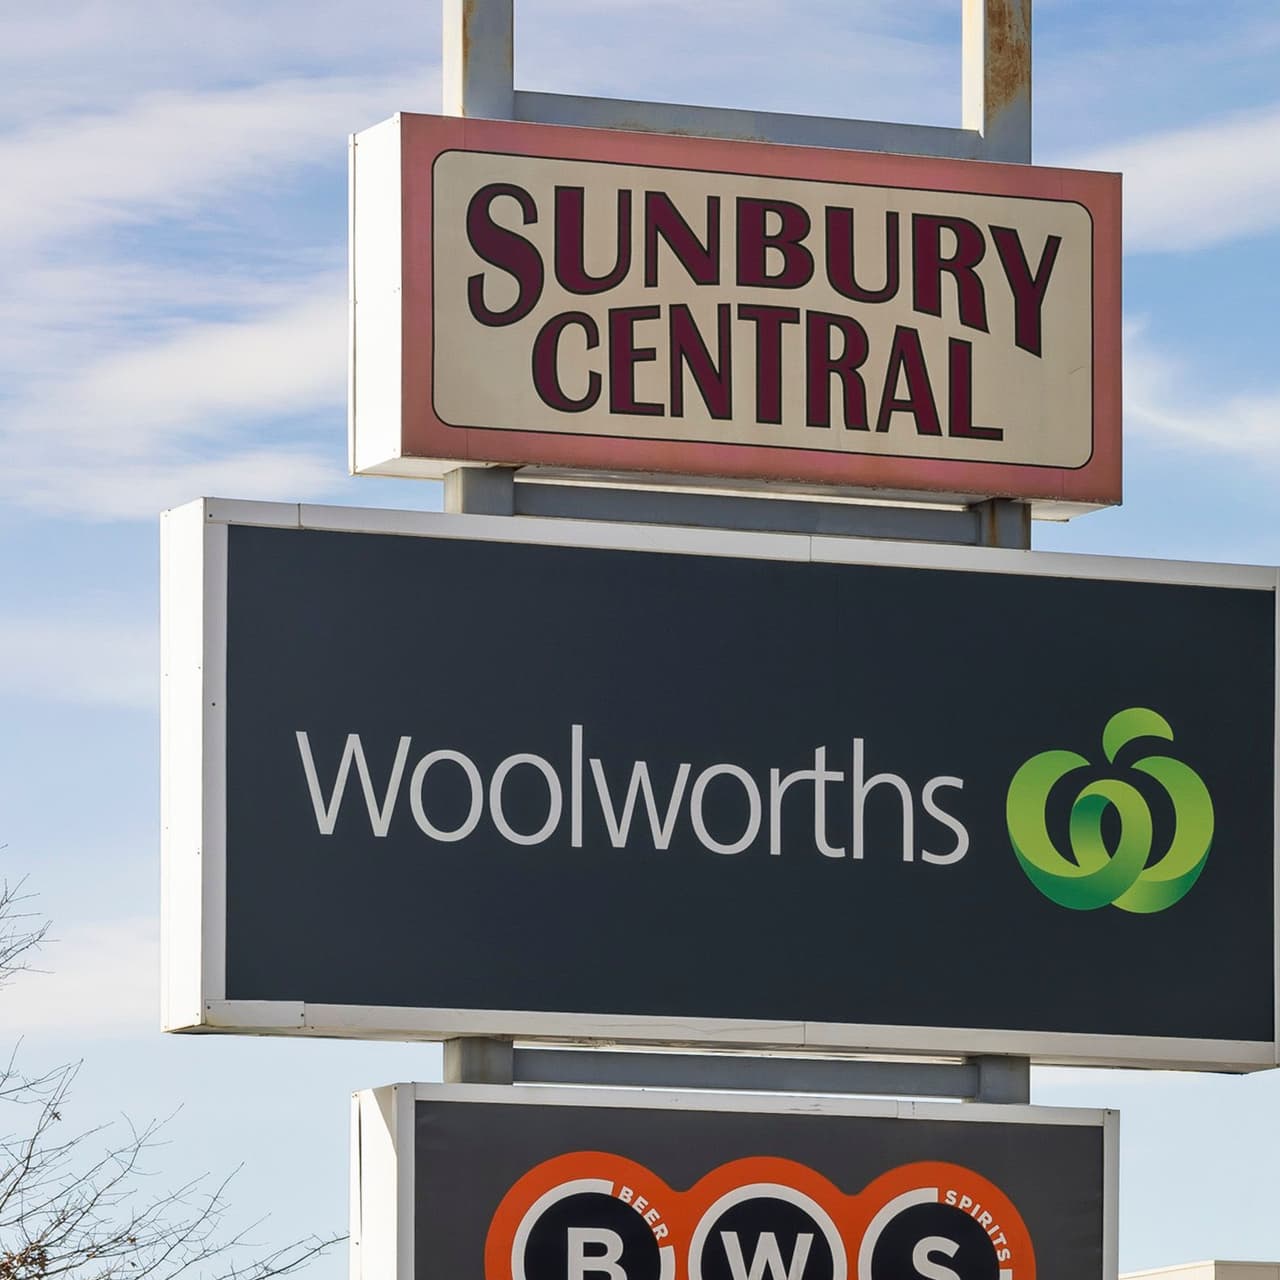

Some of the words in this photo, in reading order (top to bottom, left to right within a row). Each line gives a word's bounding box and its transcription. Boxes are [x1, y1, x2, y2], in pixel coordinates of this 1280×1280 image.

[466, 183, 1063, 358] SUNBURY
[532, 303, 1004, 442] CENTRAL
[295, 724, 970, 865] Woolworths
[617, 1185, 669, 1241] BEER
[944, 1189, 1012, 1263] SPIRITS
